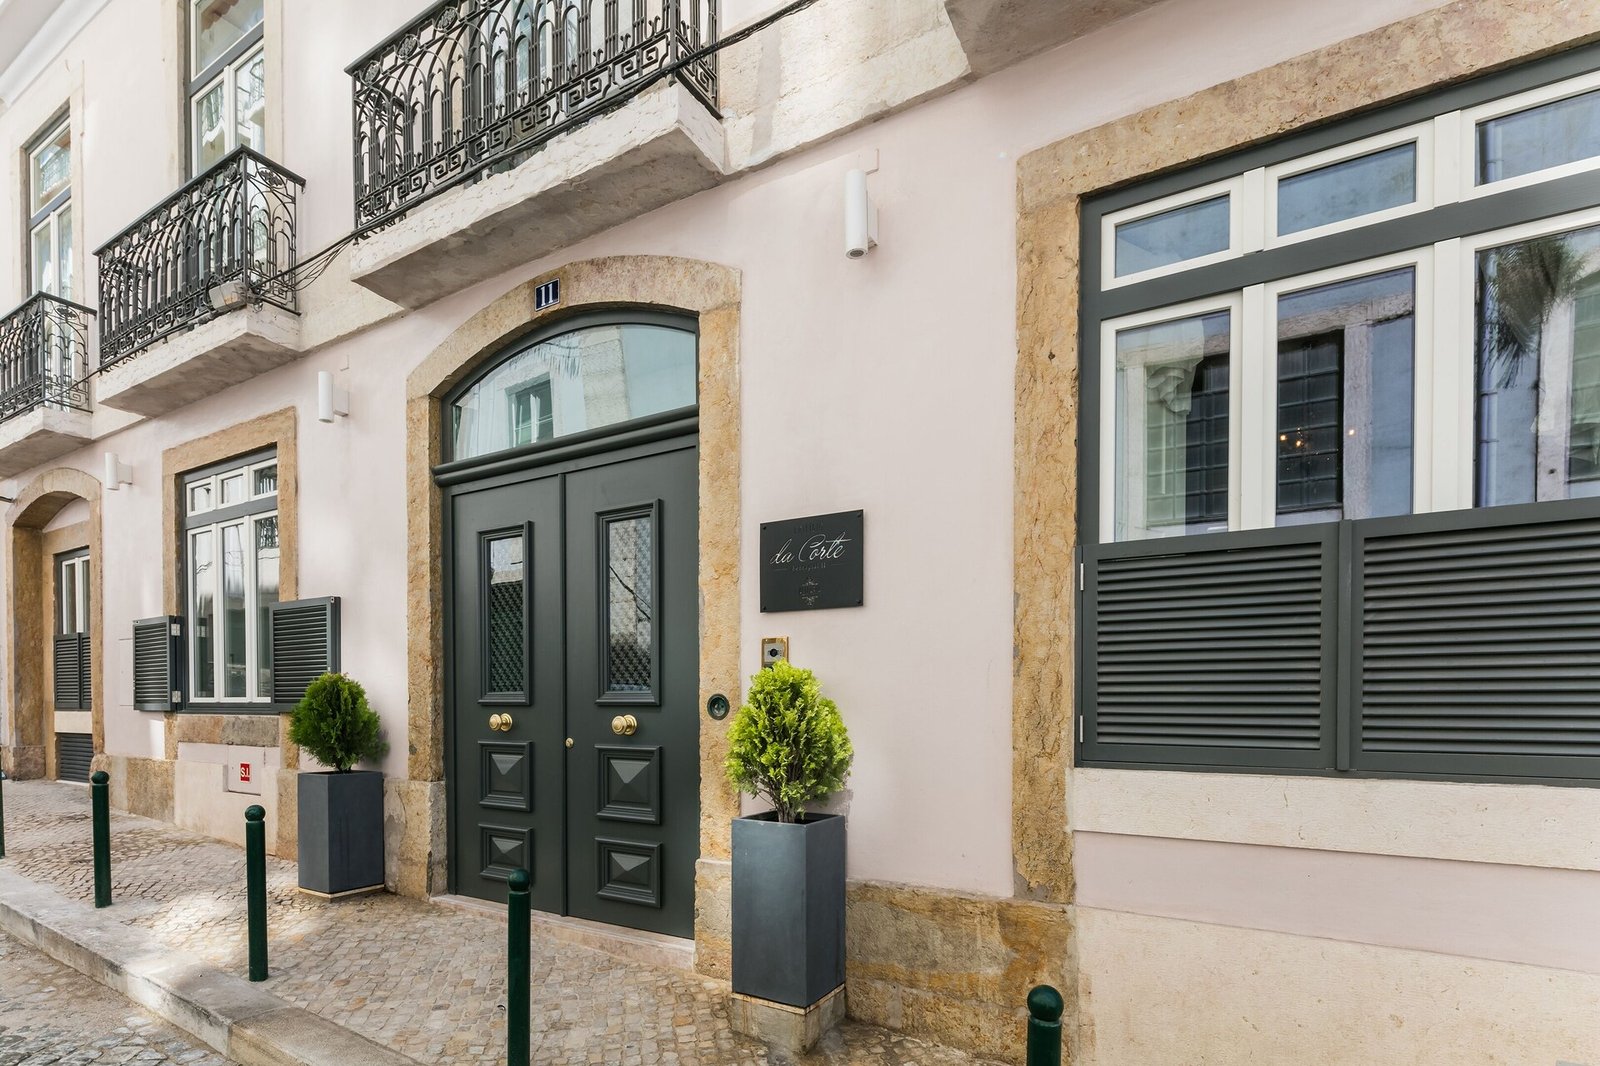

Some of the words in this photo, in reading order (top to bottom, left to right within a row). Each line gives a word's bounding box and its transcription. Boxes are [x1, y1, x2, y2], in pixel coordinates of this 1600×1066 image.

[540, 283, 553, 306] 11
[770, 539, 795, 564] da
[798, 532, 852, 562] Corte
